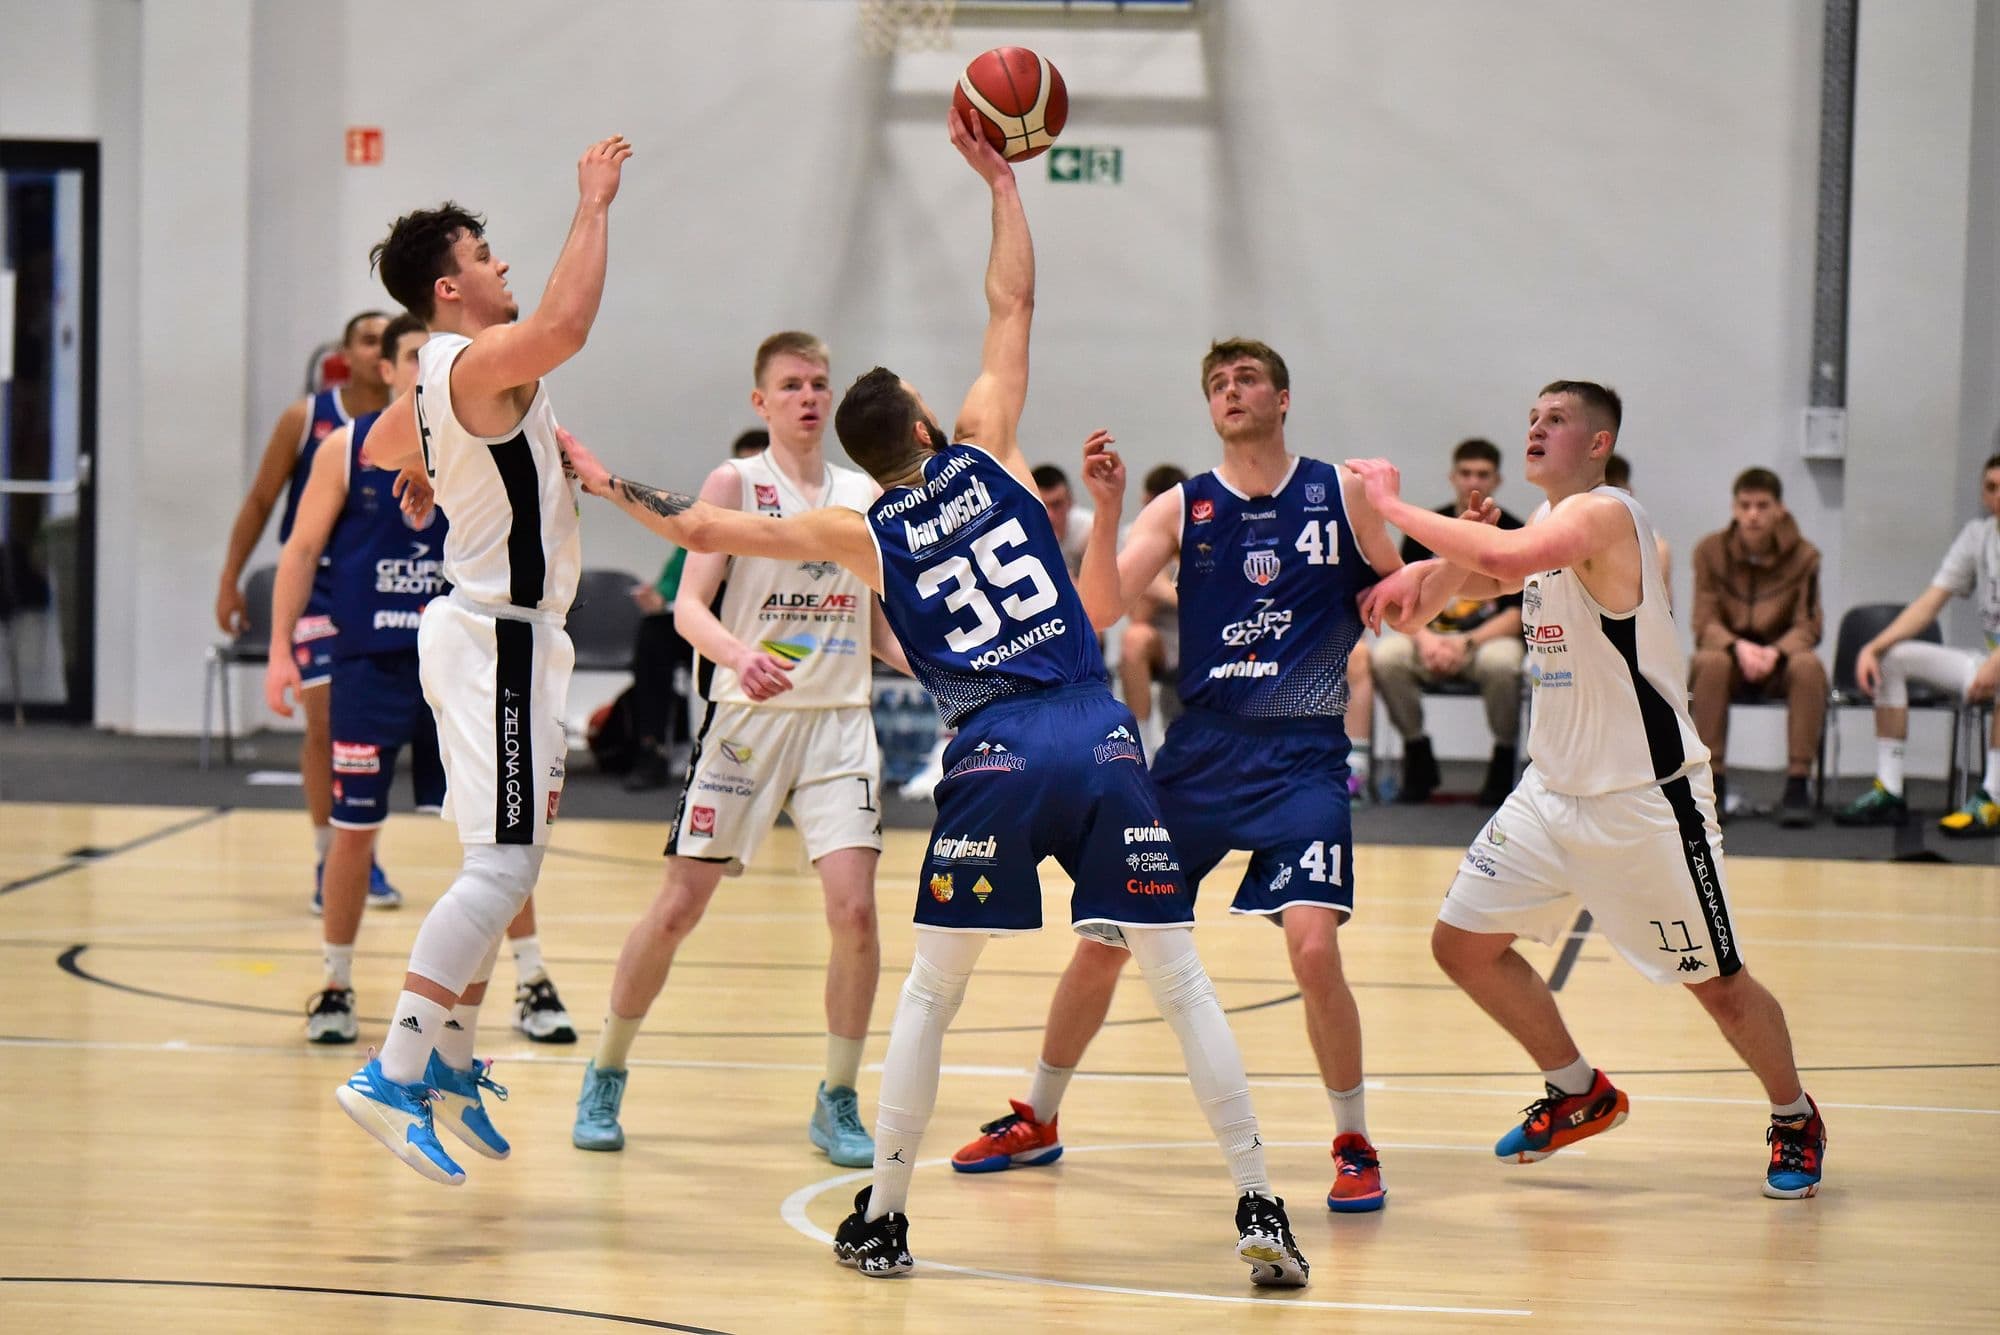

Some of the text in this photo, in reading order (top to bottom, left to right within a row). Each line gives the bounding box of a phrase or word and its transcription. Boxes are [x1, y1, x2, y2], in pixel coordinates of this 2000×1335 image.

[1294, 520, 1340, 565] 41
[376, 559, 445, 577] GRUP
[915, 517, 1059, 654] 35
[969, 618, 1066, 672] MORAWIEC
[505, 706, 520, 779] ZIELONA
[1140, 852, 1169, 862] OSADA
[1299, 841, 1342, 887] 41
[1692, 852, 1719, 918] ZIELONA
[1649, 920, 1703, 953] 11
[1569, 1110, 1585, 1126] 13
